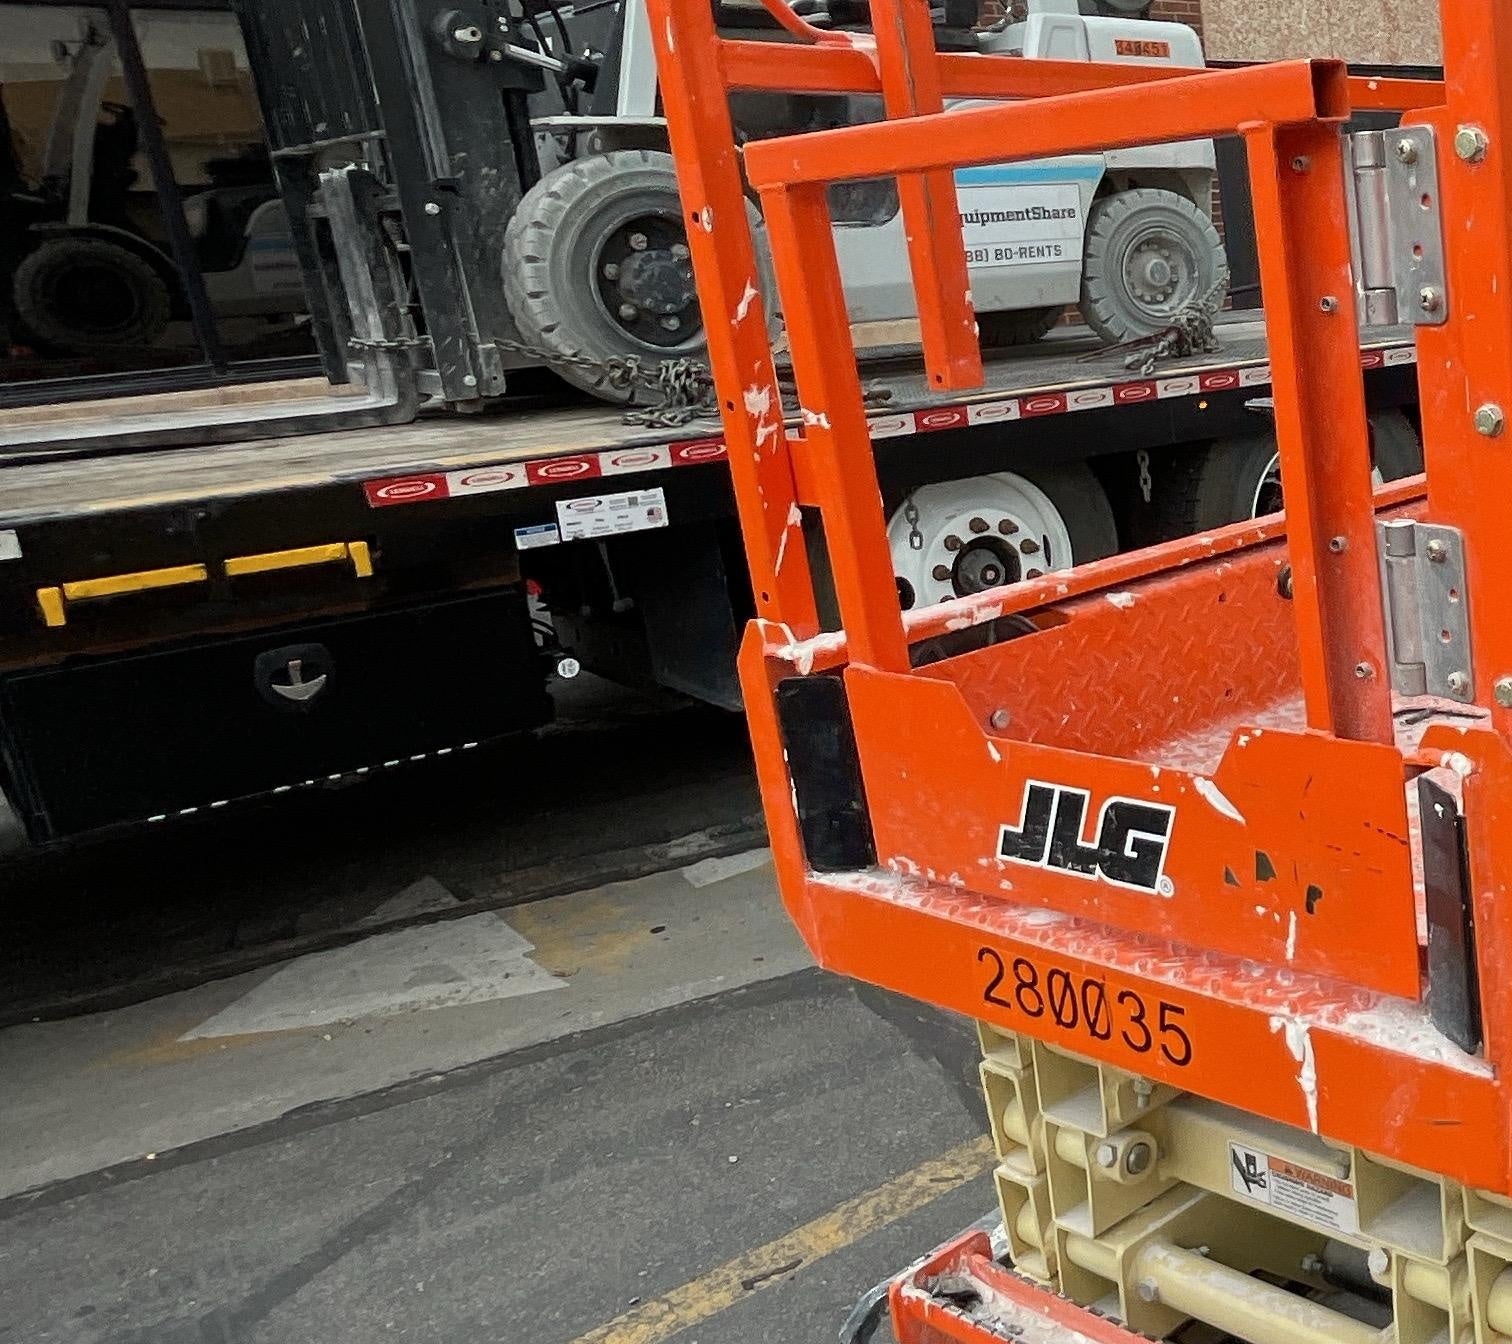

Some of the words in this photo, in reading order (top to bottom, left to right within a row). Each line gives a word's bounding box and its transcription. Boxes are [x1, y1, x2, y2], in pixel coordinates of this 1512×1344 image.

[960, 206, 1076, 227] uipmentShare
[965, 248, 989, 262] 88)
[994, 244, 1062, 260] 80-RENTS
[997, 780, 1175, 895] JLG
[978, 946, 1193, 1067] 280035
